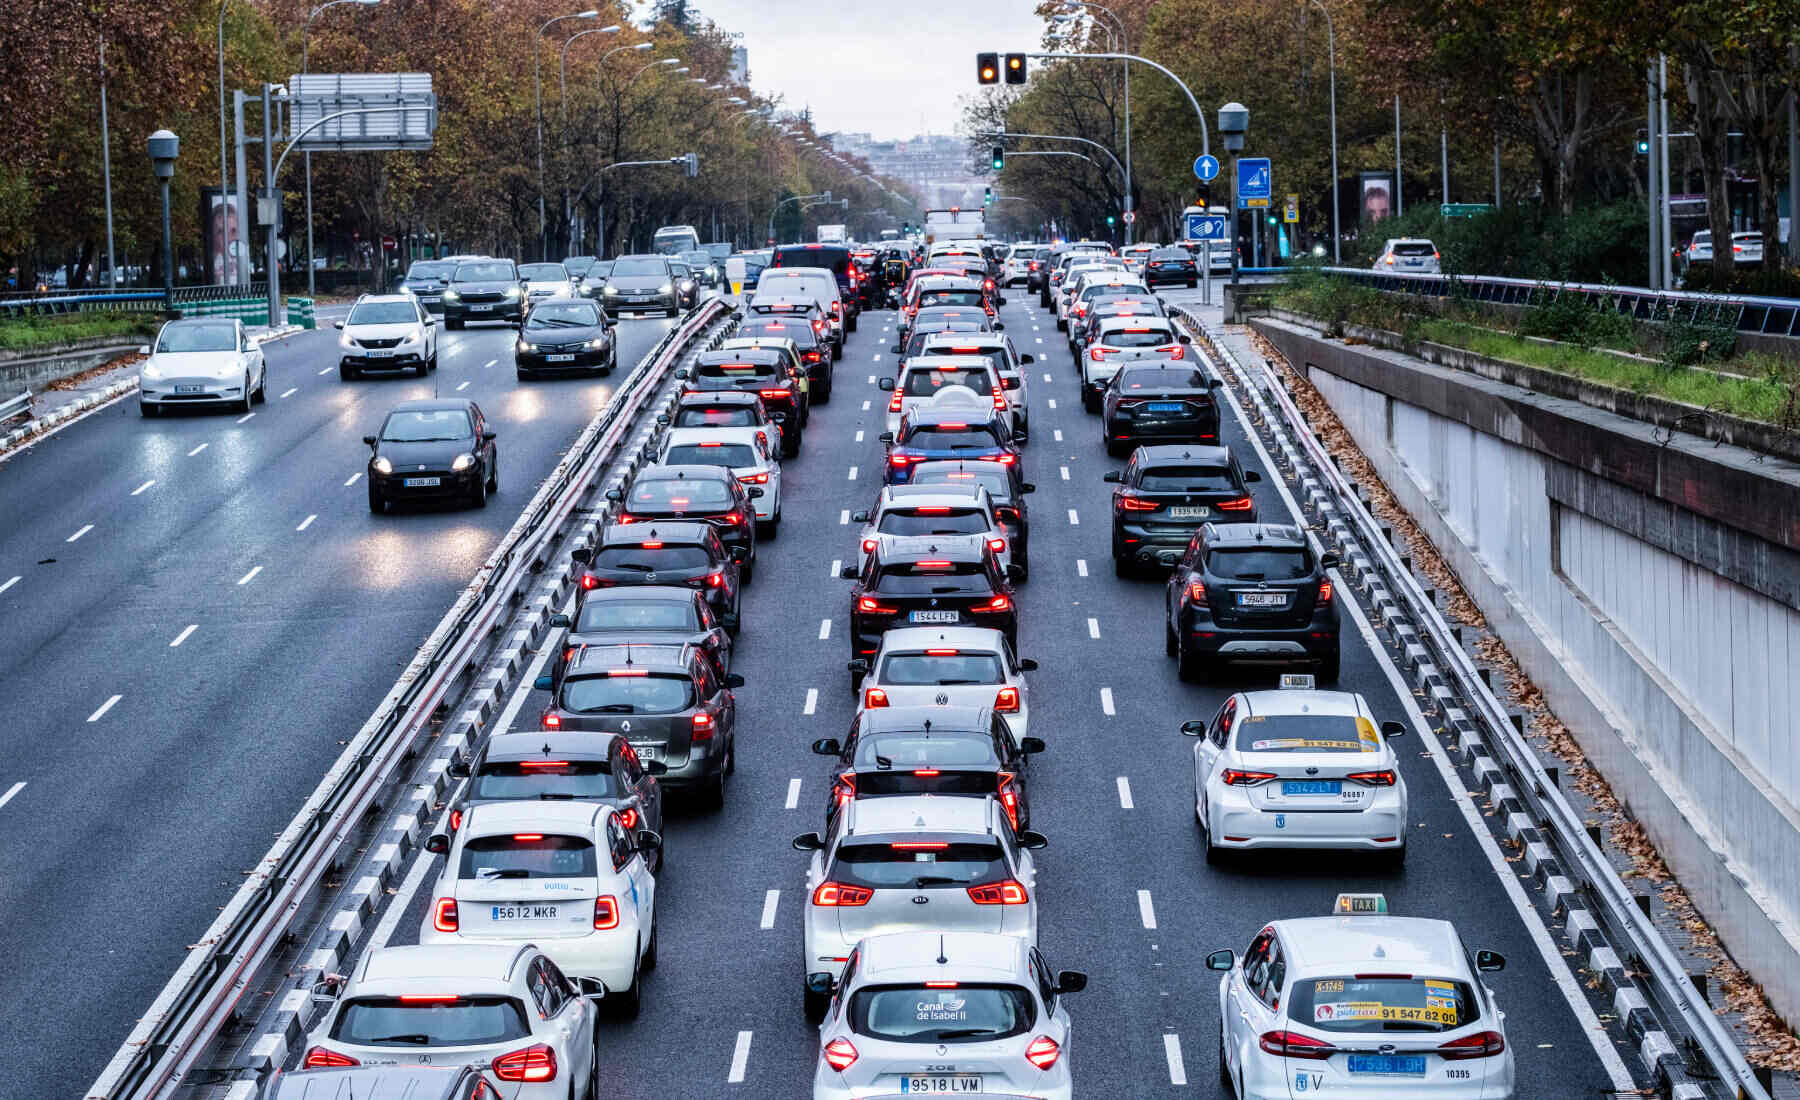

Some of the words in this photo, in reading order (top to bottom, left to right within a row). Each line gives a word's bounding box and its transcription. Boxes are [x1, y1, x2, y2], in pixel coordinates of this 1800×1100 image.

[1352, 898, 1375, 911] TAXI
[499, 907, 530, 919] 5612
[534, 907, 557, 919] MKR
[916, 1002, 944, 1011] Canal
[916, 1011, 929, 1020] de
[930, 1011, 958, 1021] Isabel
[1382, 1009, 1396, 1018] 91
[1400, 1009, 1421, 1019] 547
[1424, 1012, 1439, 1021] 82
[1442, 1013, 1456, 1023] 00
[912, 1079, 947, 1092] 9518
[952, 1079, 978, 1092] LVM
